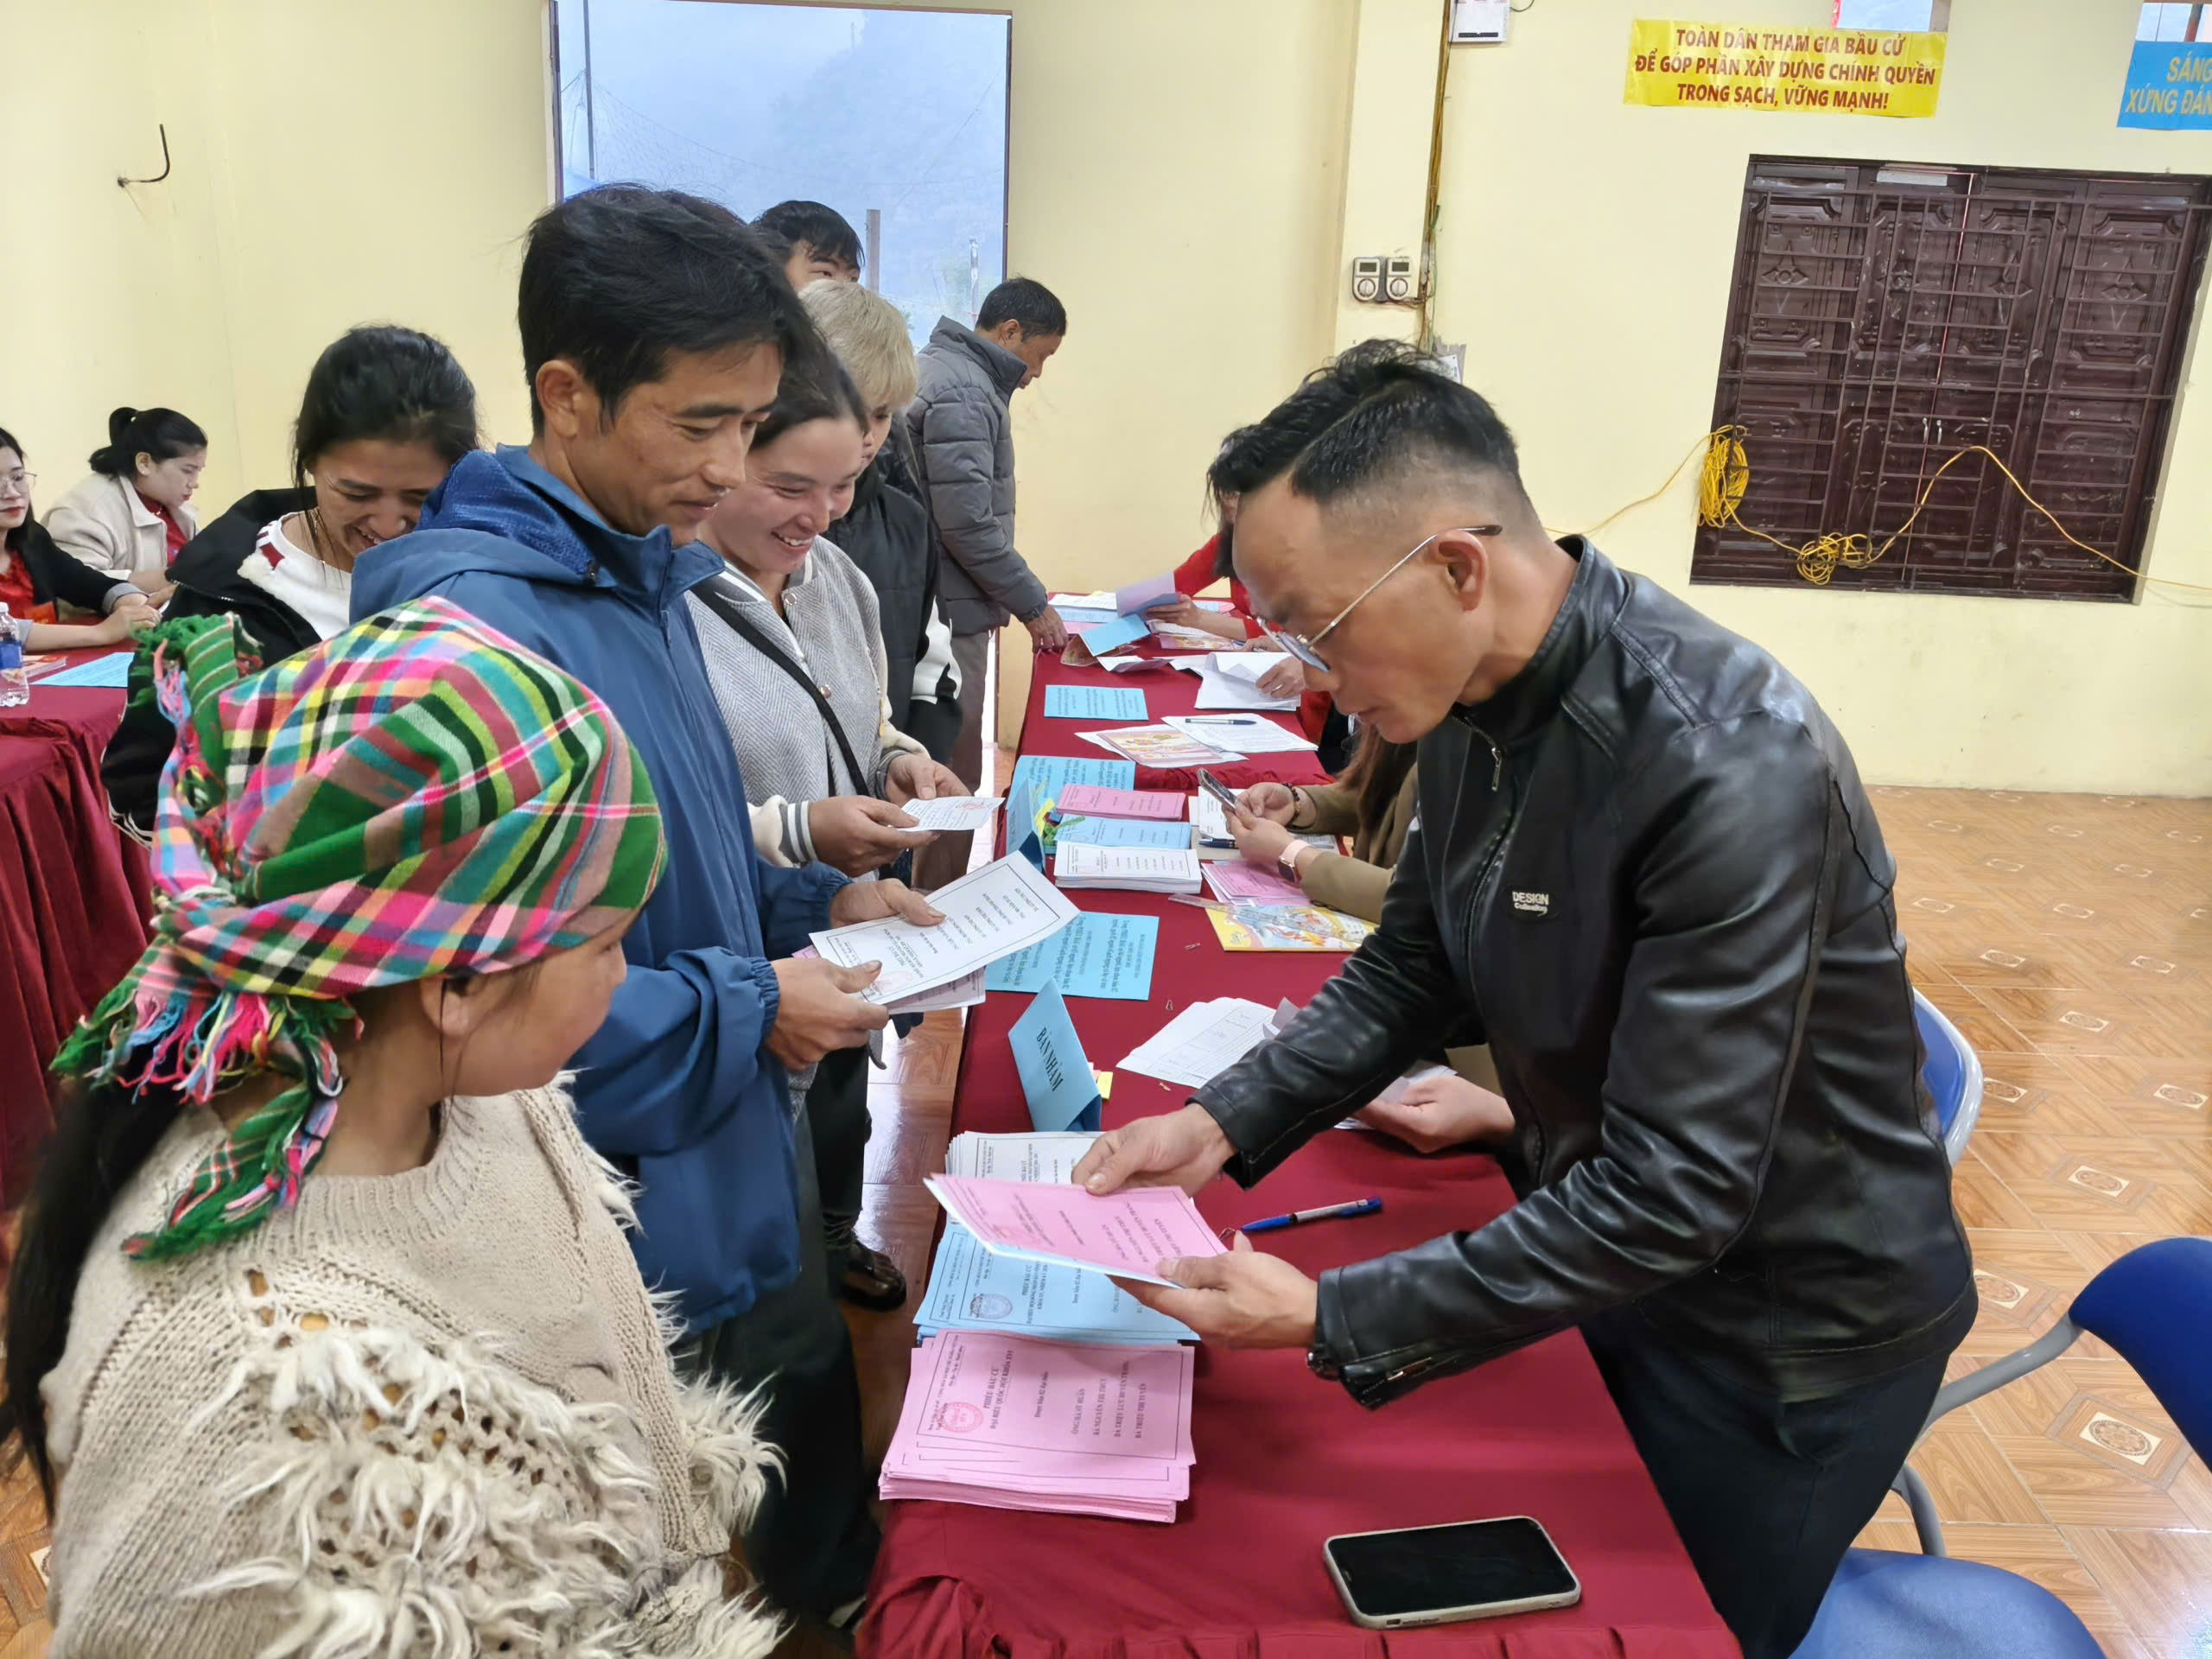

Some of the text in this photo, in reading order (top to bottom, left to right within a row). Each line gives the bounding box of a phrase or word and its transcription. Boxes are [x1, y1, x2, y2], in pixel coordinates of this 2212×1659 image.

[1676, 26, 1908, 56] TOÀN DÂN THAM GIA BẦU CỬ
[1635, 48, 1936, 86] ĐỂ GÓP PHẦN XÂY DỰNG CHÍNH QUYỀN
[1676, 83, 1890, 113] TRONG SẠCH, VỮNG MẠNH!
[2126, 83, 2178, 115] XỨNG
[1512, 891, 1549, 906] DESIGN
